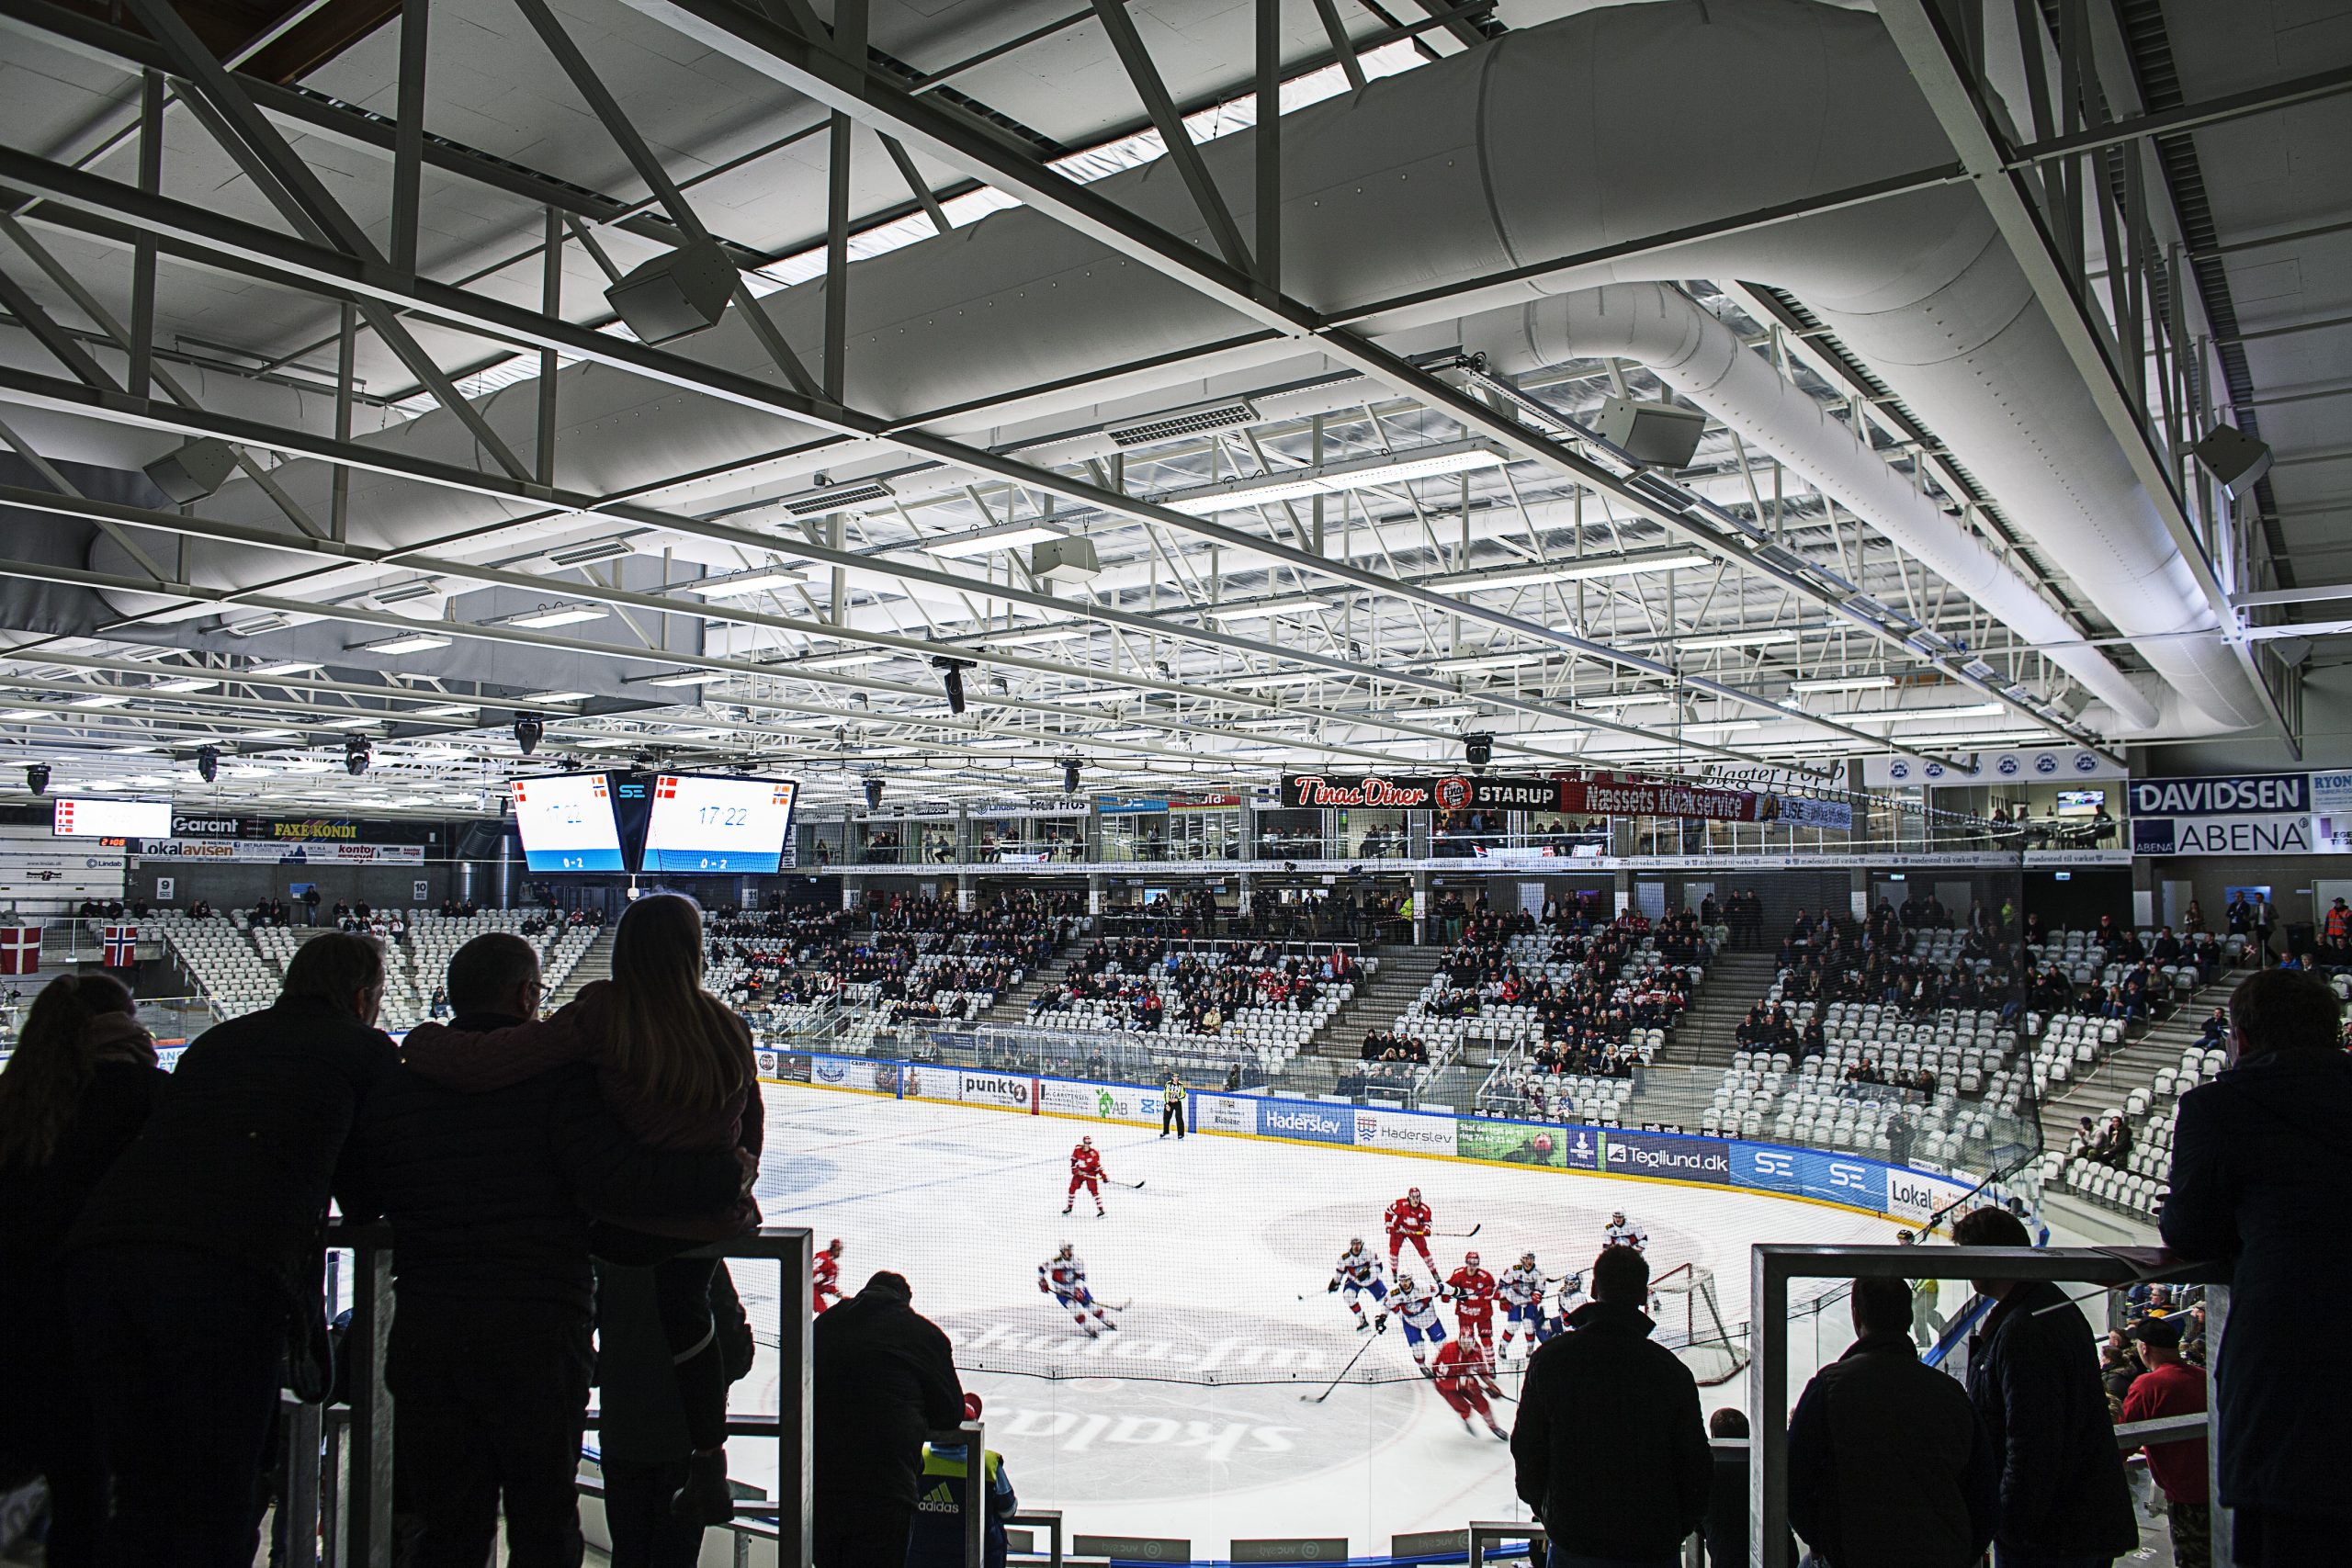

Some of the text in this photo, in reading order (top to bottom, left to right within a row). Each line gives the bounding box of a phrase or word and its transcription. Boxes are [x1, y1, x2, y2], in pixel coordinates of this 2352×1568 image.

[1295, 777, 1429, 806] Tinas Diner
[1478, 786, 1555, 804] STARUP
[2139, 778, 2300, 812] DAVIDSEN
[1585, 784, 1743, 818] Næssets Kloakservice
[172, 817, 239, 832] Garant
[274, 823, 356, 838] FAXE KONDI
[2178, 823, 2308, 852] ABENA
[139, 840, 233, 856] Lokalavisen
[338, 845, 376, 853] kontor
[2136, 843, 2170, 852] ABENA
[2028, 854, 2062, 863] mødested
[162, 880, 170, 890] 9
[415, 883, 426, 892] 10
[966, 892, 976, 902] 12
[1266, 1110, 1340, 1134] Haderslev
[1381, 1126, 1452, 1144] Haderslev
[1628, 1146, 1728, 1173] Tegllund.dk
[1755, 1152, 1793, 1177] SE
[1829, 1163, 1866, 1190] SE
[919, 1500, 959, 1514] adidas
